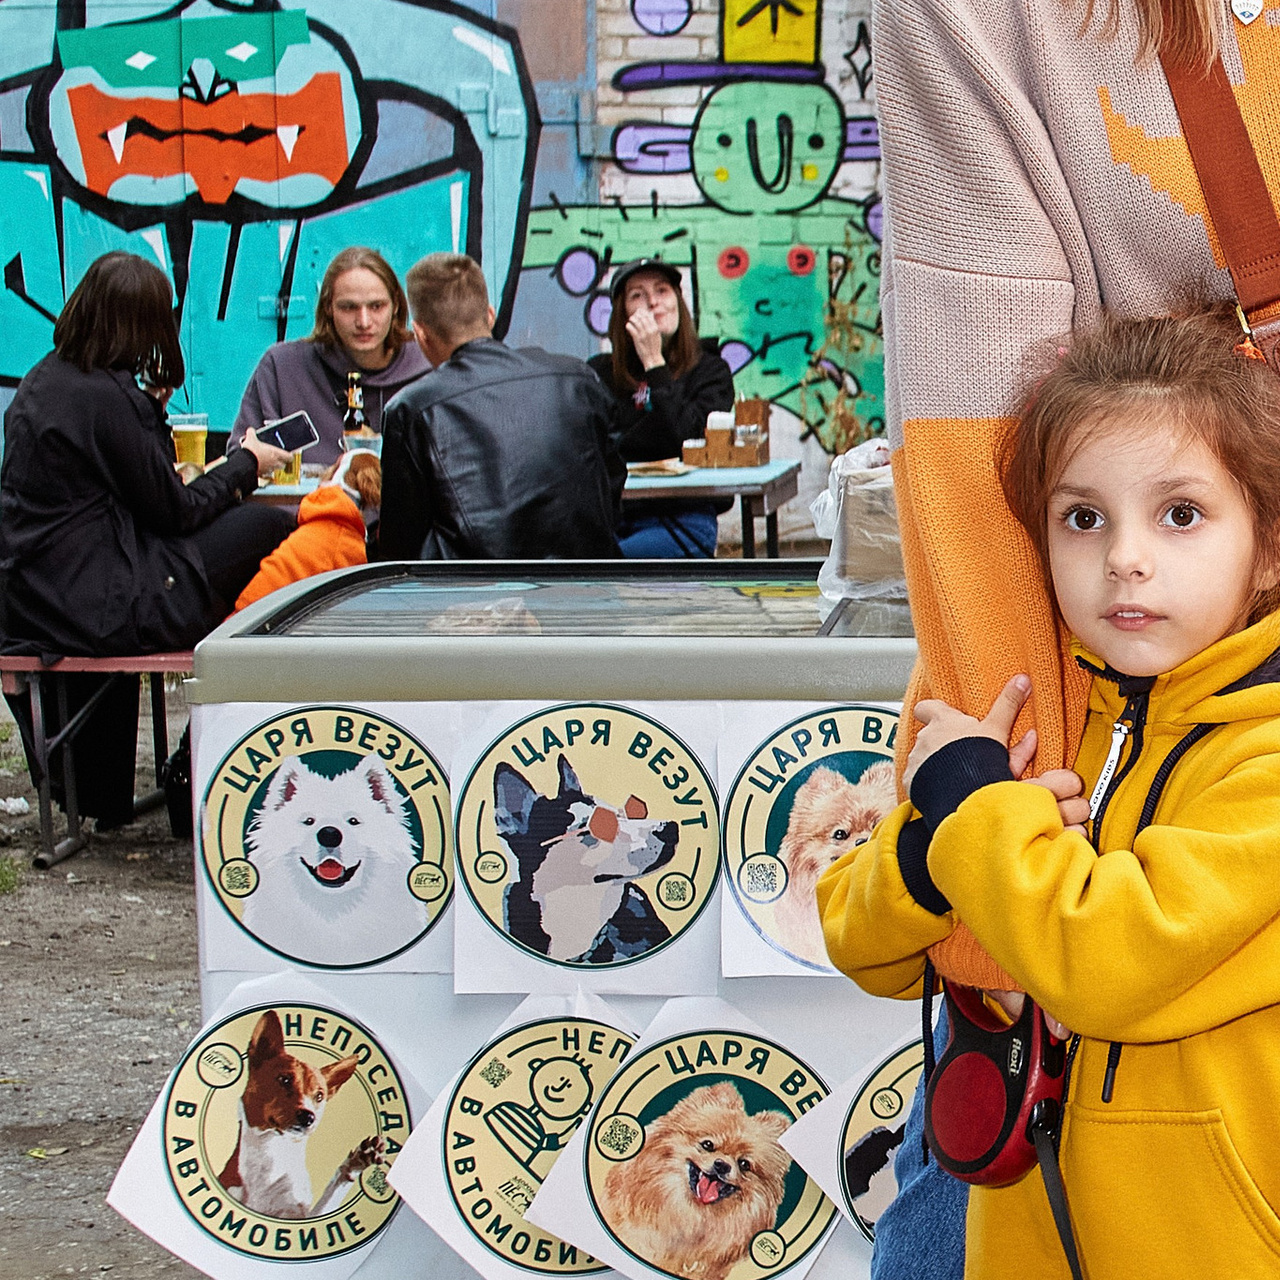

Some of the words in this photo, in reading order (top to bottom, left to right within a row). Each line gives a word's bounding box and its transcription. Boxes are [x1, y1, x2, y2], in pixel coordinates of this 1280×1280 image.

[223, 718, 314, 794] ЦАРЯ
[334, 716, 438, 792] ВЕЗУТ
[511, 719, 611, 767] ЦАРЯ
[628, 731, 709, 829] ВЕЗУТ
[748, 717, 841, 794] ЦАРЯ
[285, 1014, 403, 1157] НЕПОСЕДА
[664, 1039, 771, 1075] ЦАРЯ
[174, 1100, 198, 1118] В
[460, 1095, 485, 1117] В
[172, 1136, 367, 1252] АВТОМОБИЛЕ
[452, 1131, 598, 1266] АВТОМОБИ
